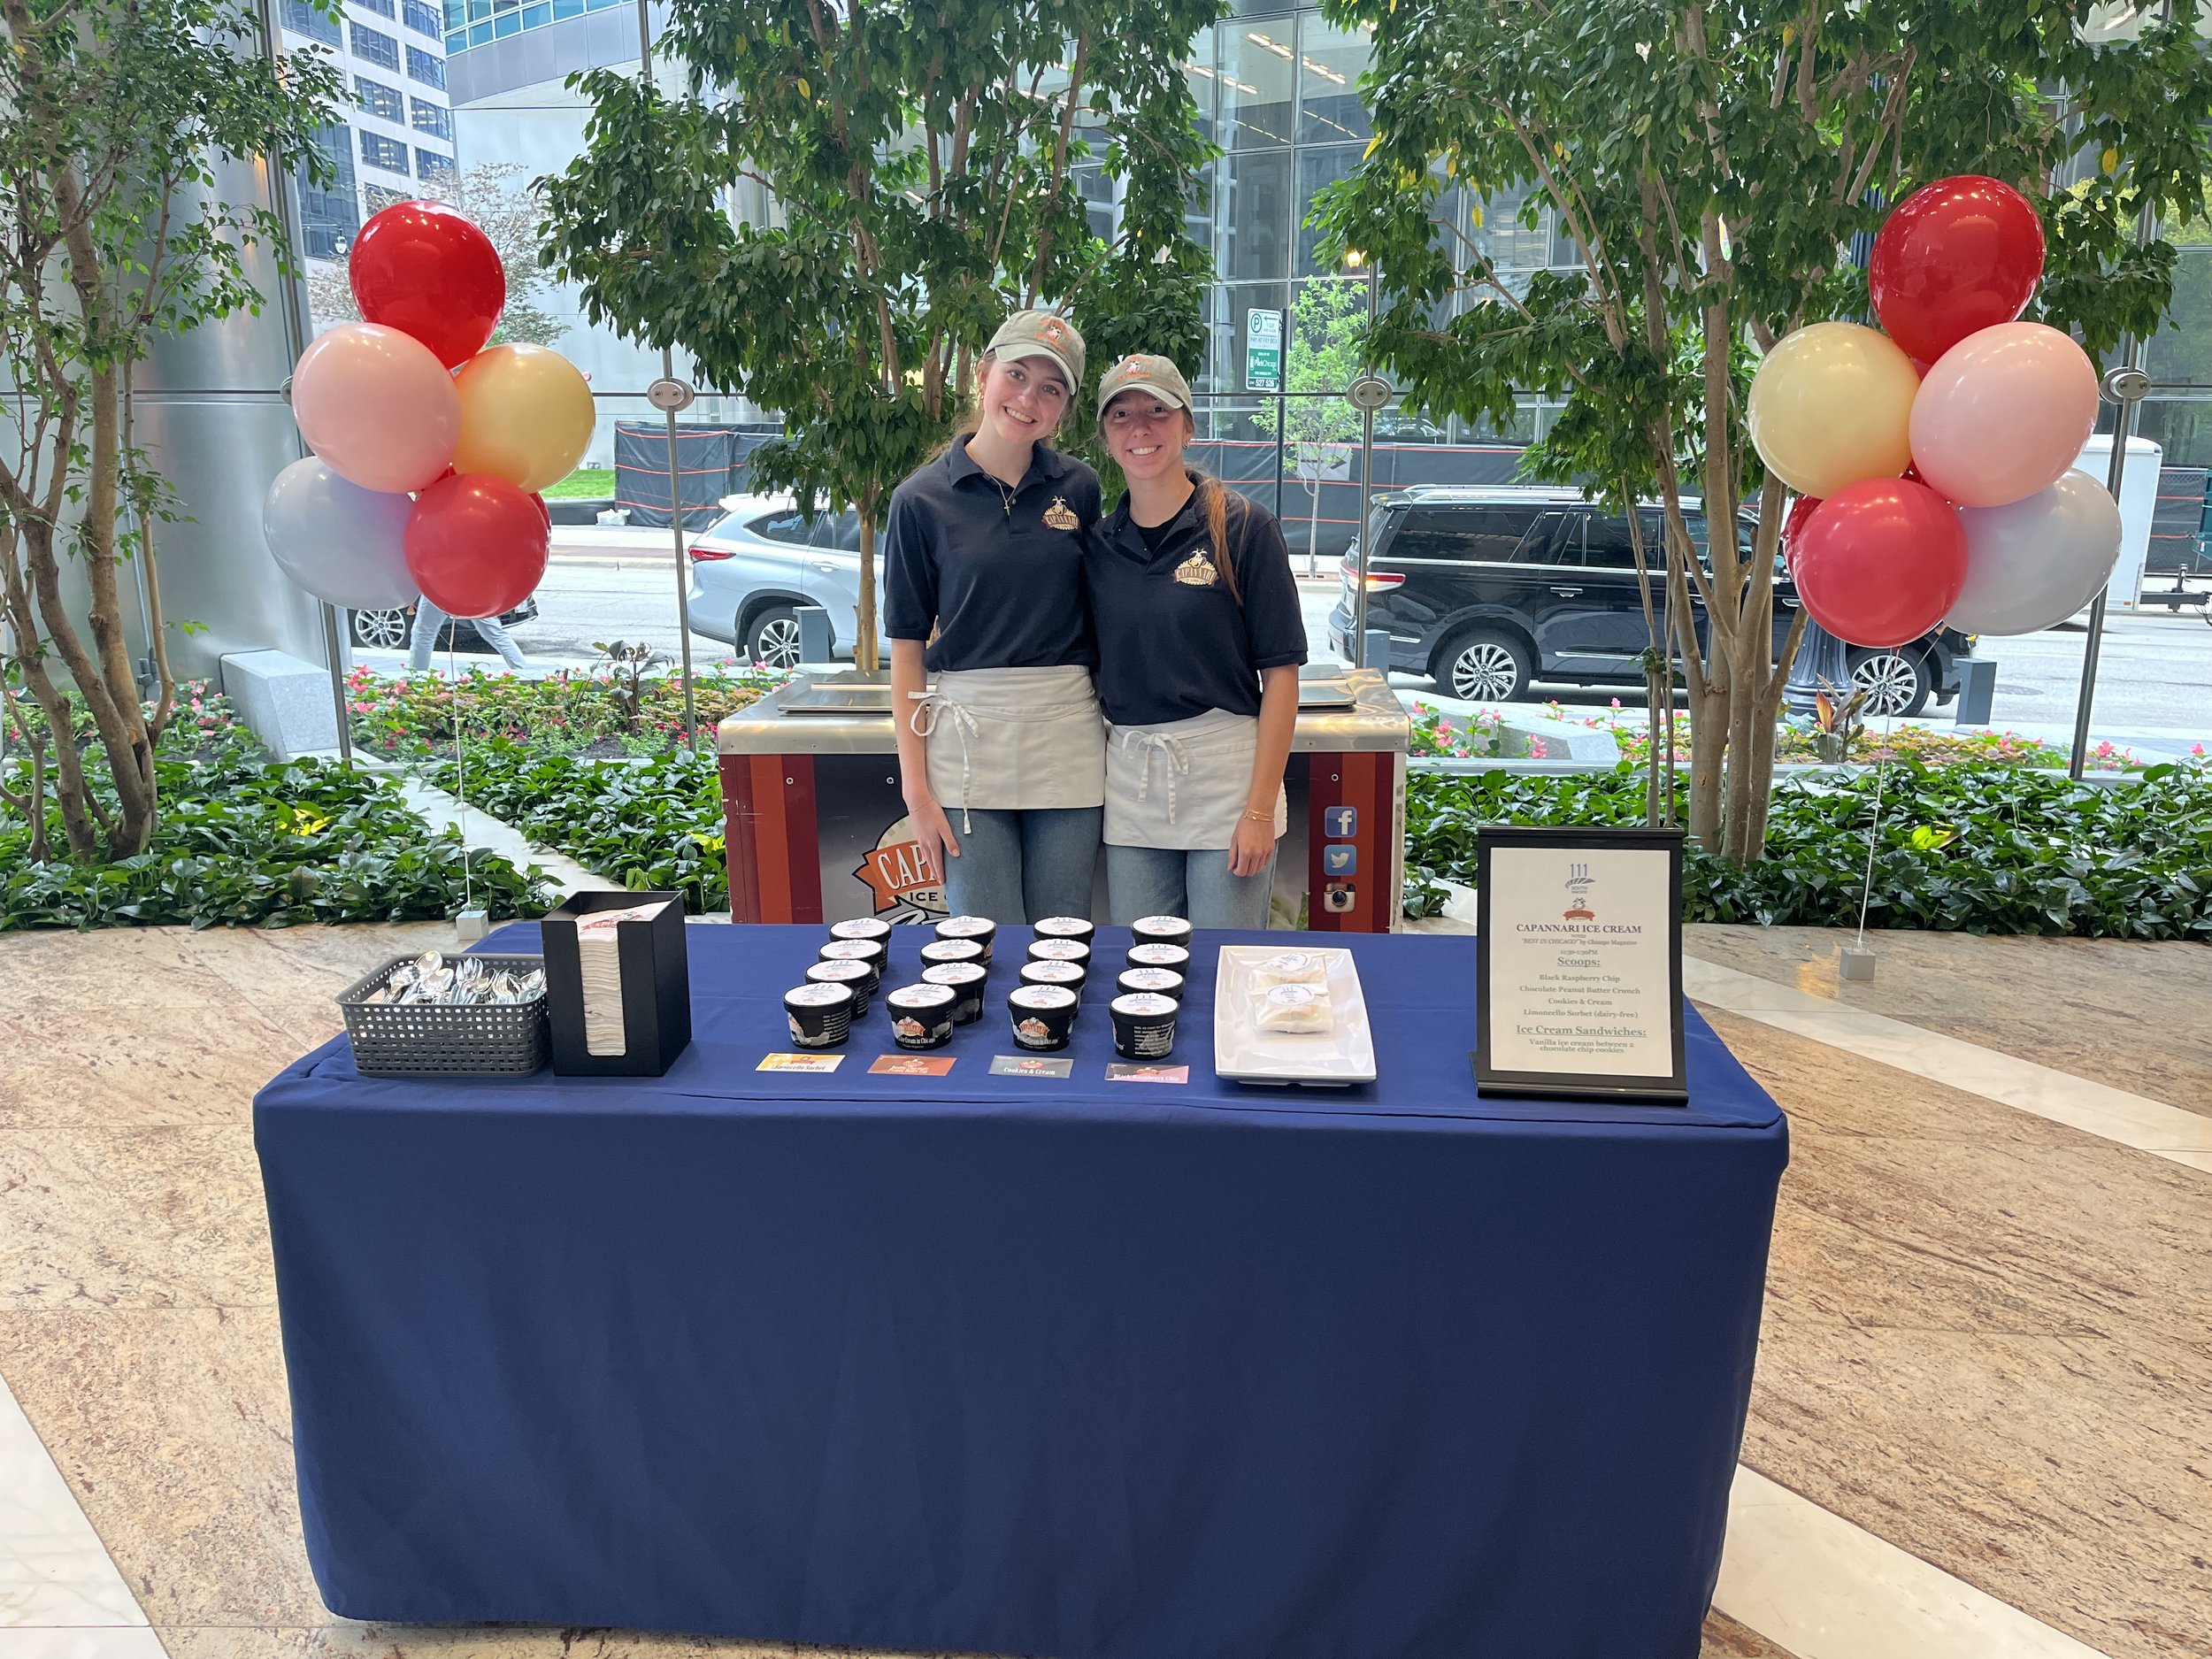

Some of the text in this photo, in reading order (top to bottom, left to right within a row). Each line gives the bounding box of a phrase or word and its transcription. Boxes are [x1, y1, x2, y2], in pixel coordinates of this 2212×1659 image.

[1254, 317, 1260, 329] P
[1570, 863, 1587, 878] 111
[910, 892, 938, 902] ICE
[1516, 924, 1641, 934] CAPANNARI ICE CREAM
[1557, 956, 1601, 968] Scoops:
[1594, 1011, 1638, 1019] (dairy-free)
[1517, 1025, 1647, 1037] Ice Cream Sandwiches:
